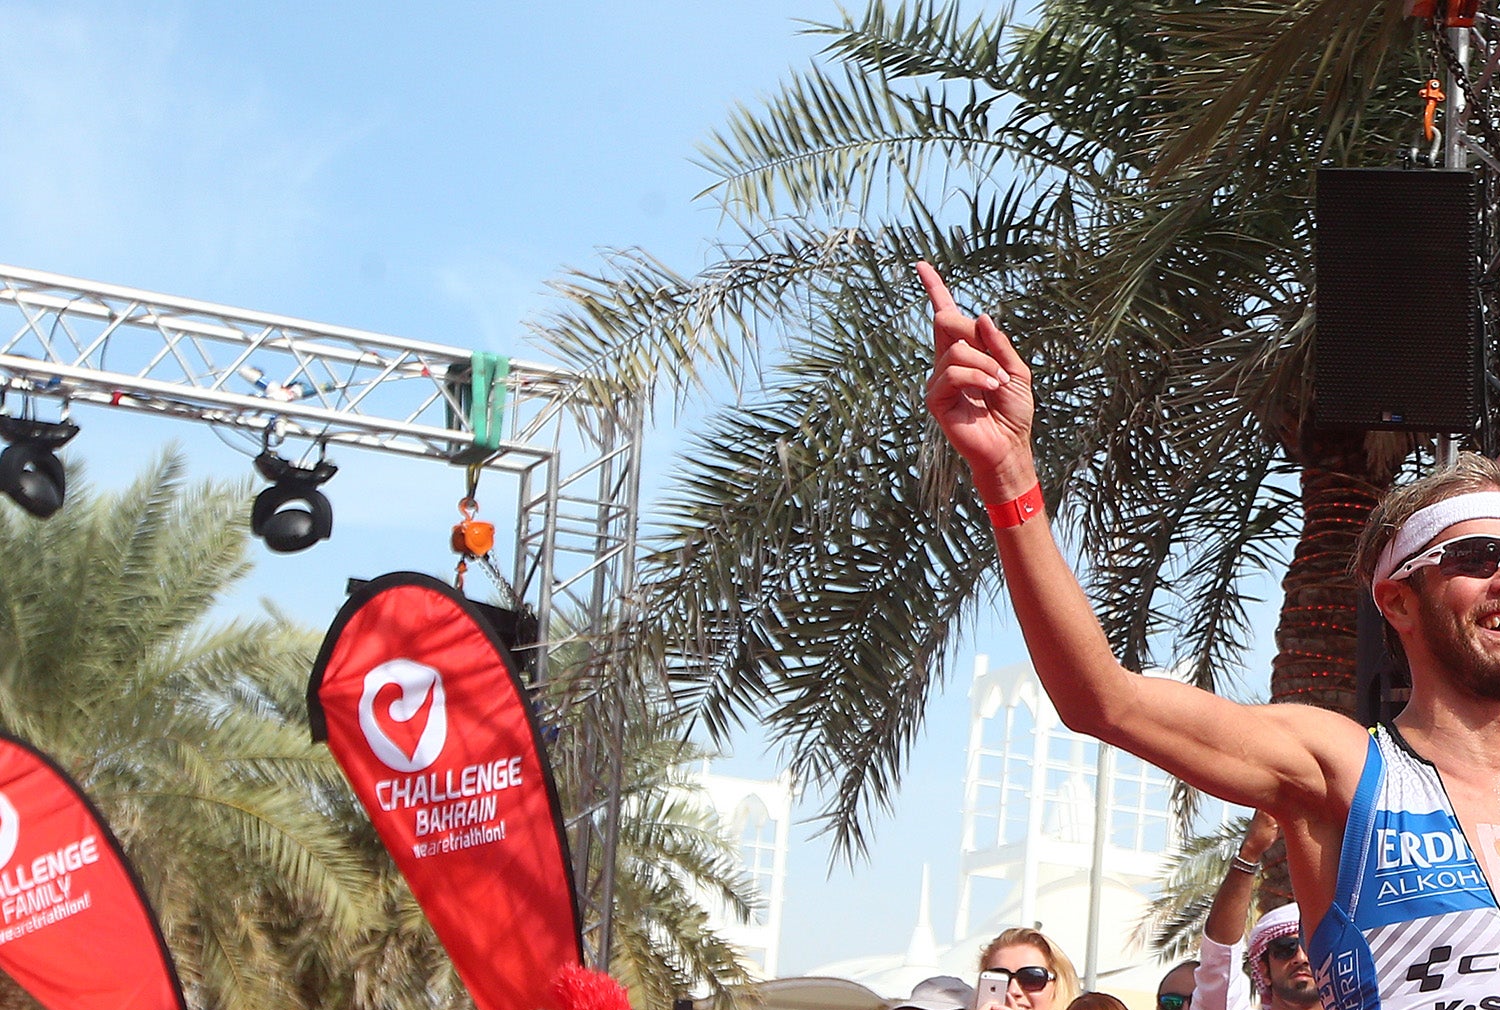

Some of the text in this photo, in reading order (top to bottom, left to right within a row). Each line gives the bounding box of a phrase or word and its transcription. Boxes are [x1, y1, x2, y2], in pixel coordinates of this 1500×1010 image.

[375, 756, 523, 811] CHALLENGE
[416, 795, 497, 837] BAHRAIN
[0, 835, 100, 899] LLENGE
[2, 874, 72, 924] FAMILY
